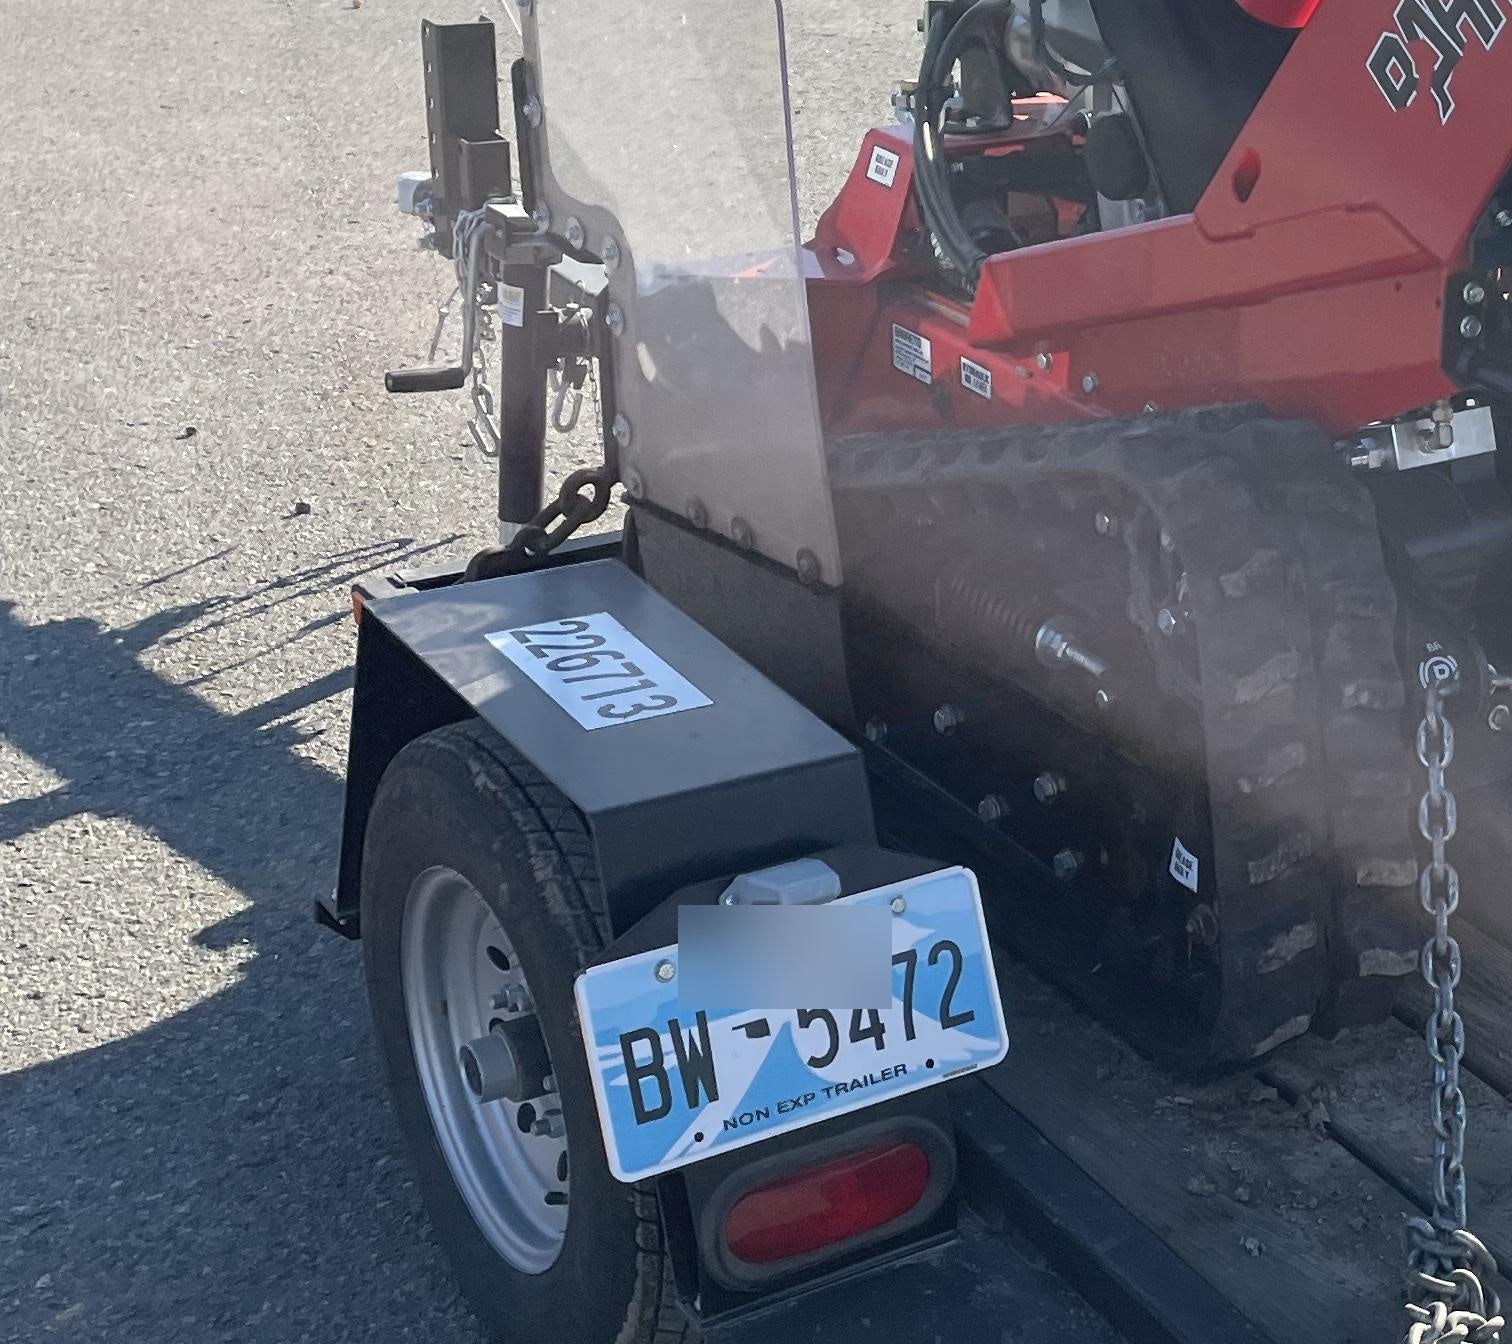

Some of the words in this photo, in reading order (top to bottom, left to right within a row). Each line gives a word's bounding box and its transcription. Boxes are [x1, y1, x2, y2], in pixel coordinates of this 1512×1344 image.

[511, 620, 678, 719] 226713
[619, 1010, 720, 1126] BW
[723, 1106, 770, 1131] NON
[776, 1092, 816, 1114] EXP
[821, 1063, 908, 1099] TRAILER
